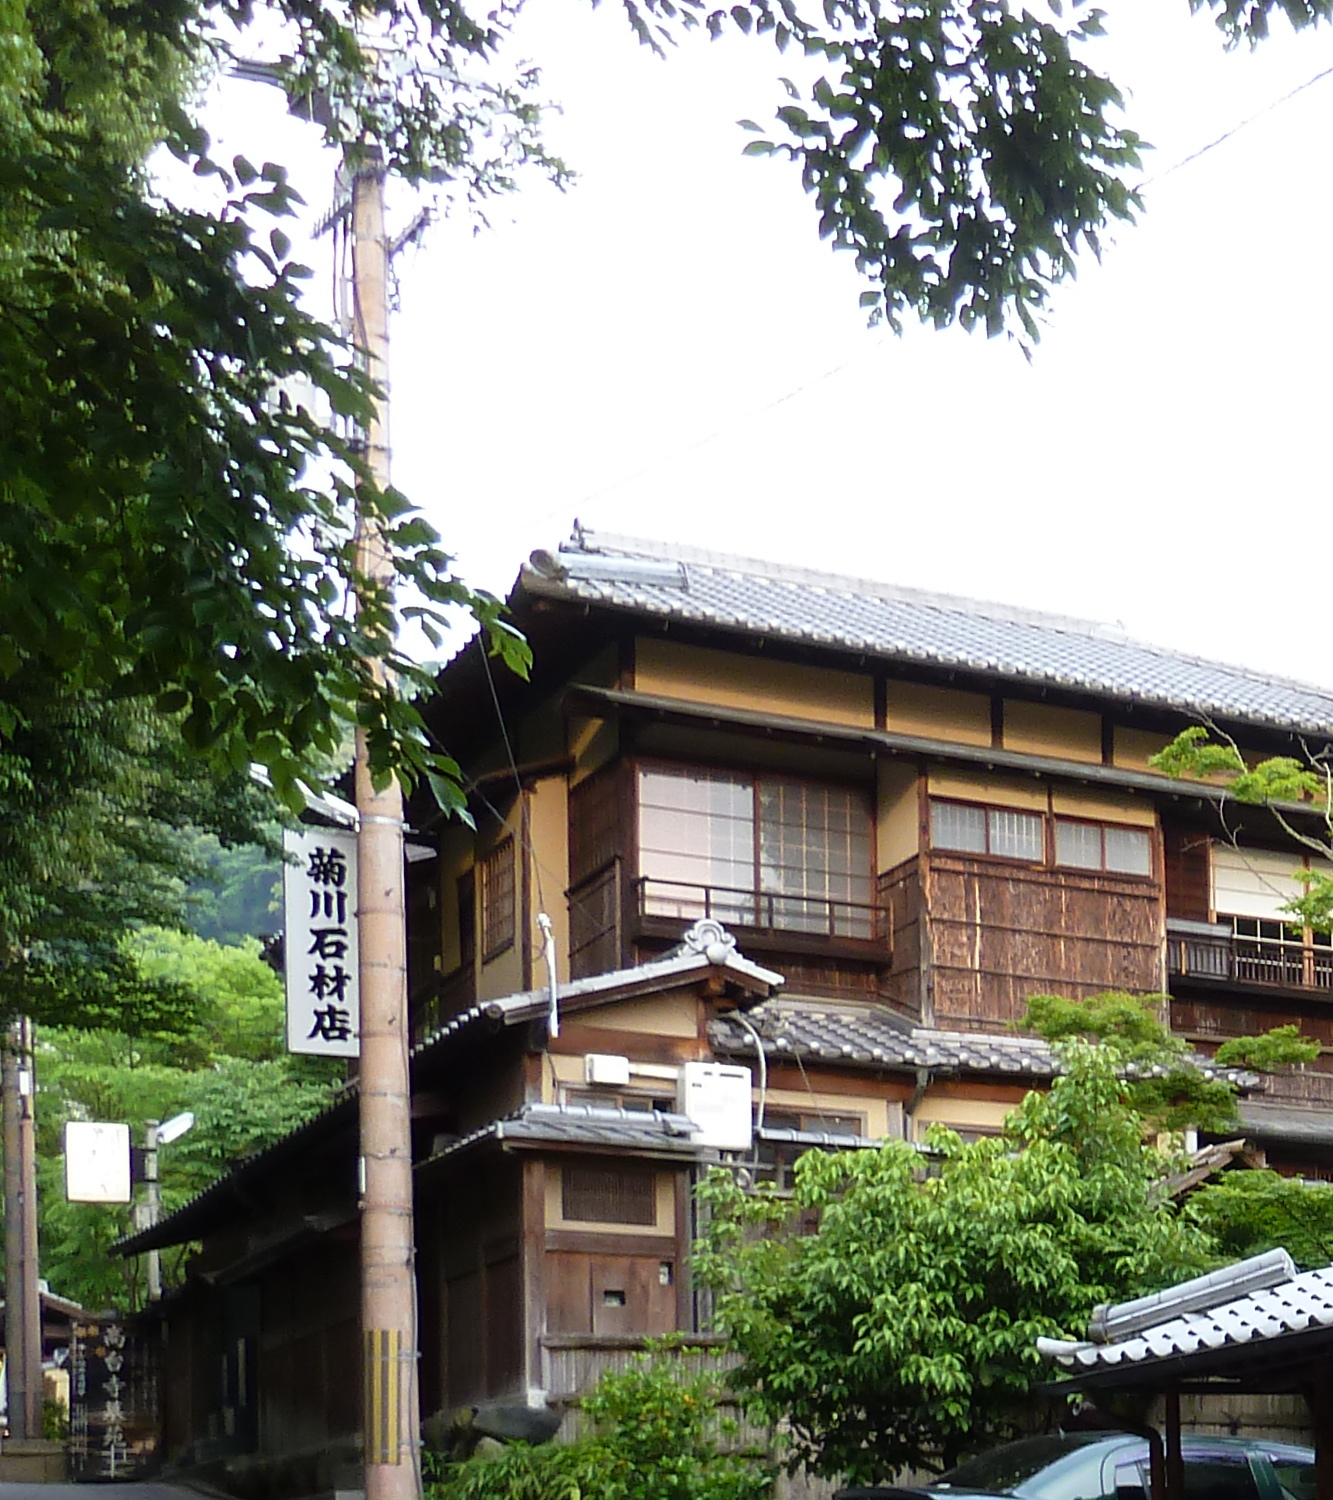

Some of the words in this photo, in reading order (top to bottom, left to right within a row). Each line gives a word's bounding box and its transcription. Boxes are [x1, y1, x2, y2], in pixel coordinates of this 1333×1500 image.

[307, 846, 352, 1043] 菊川石材店
